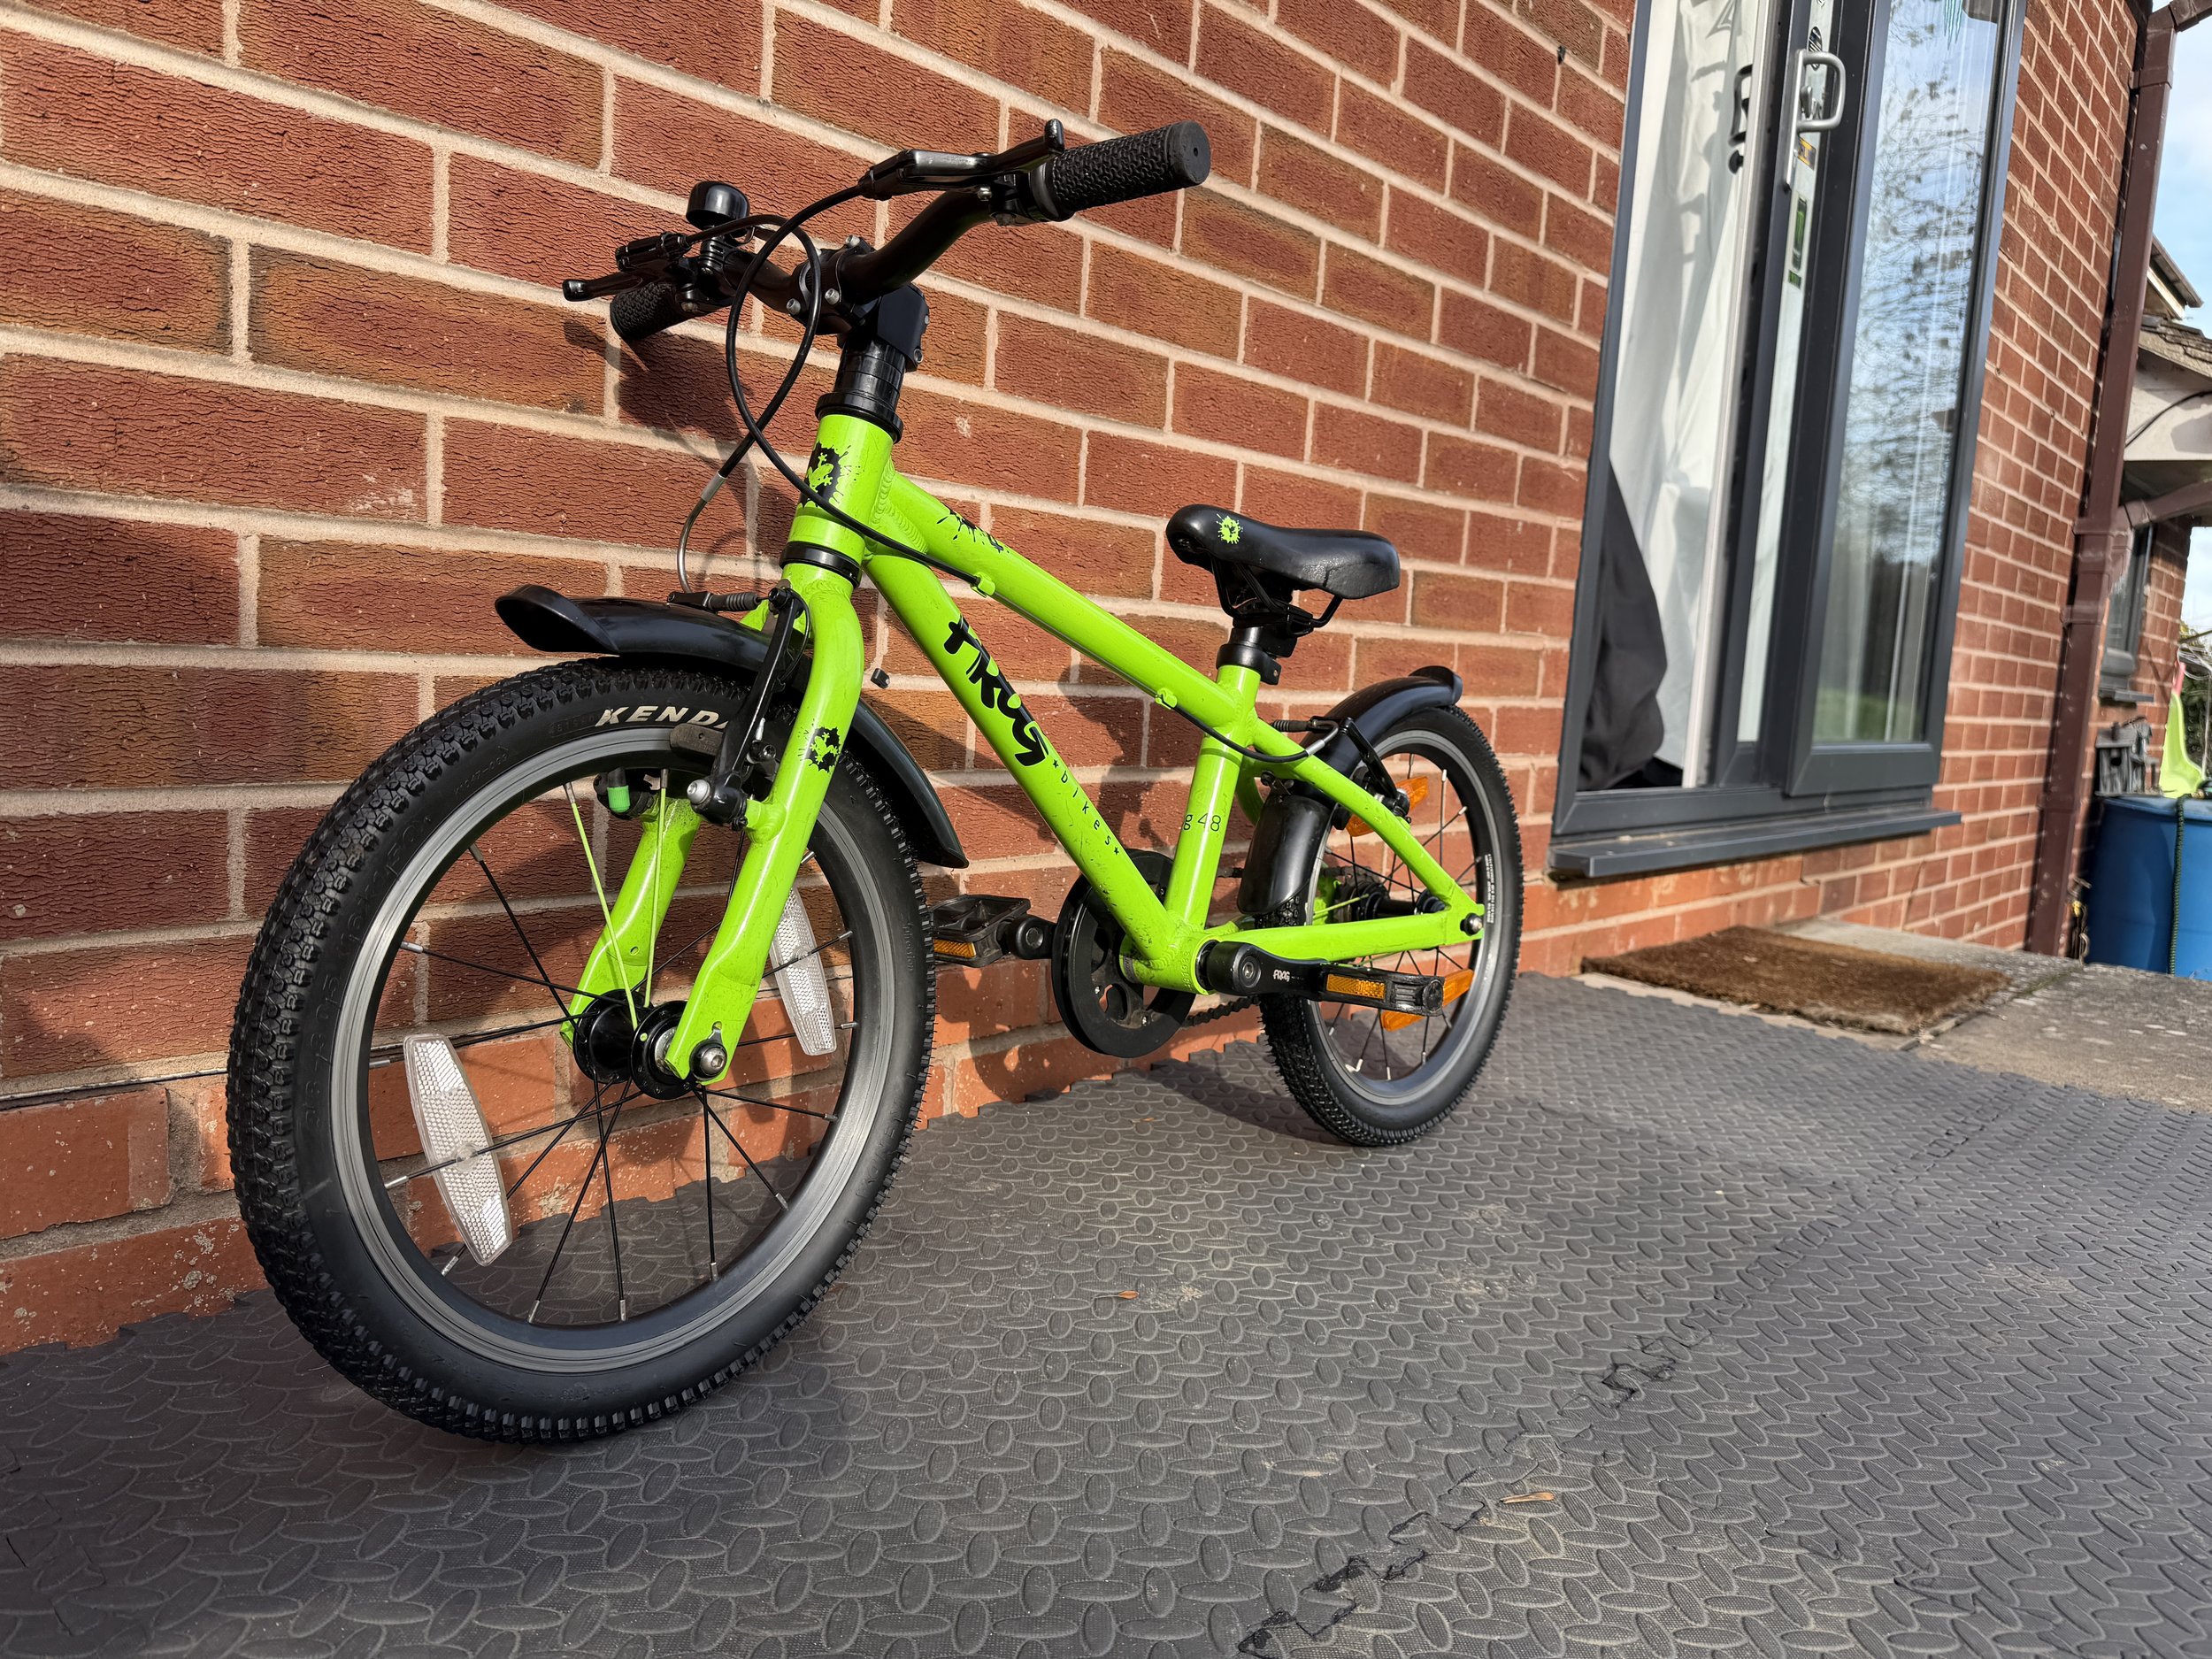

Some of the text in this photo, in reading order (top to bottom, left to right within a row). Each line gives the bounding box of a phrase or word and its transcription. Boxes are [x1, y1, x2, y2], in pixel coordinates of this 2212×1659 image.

[595, 705, 729, 729] KEND
[1061, 771, 1112, 845] bikes
[1197, 812, 1222, 832] 48
